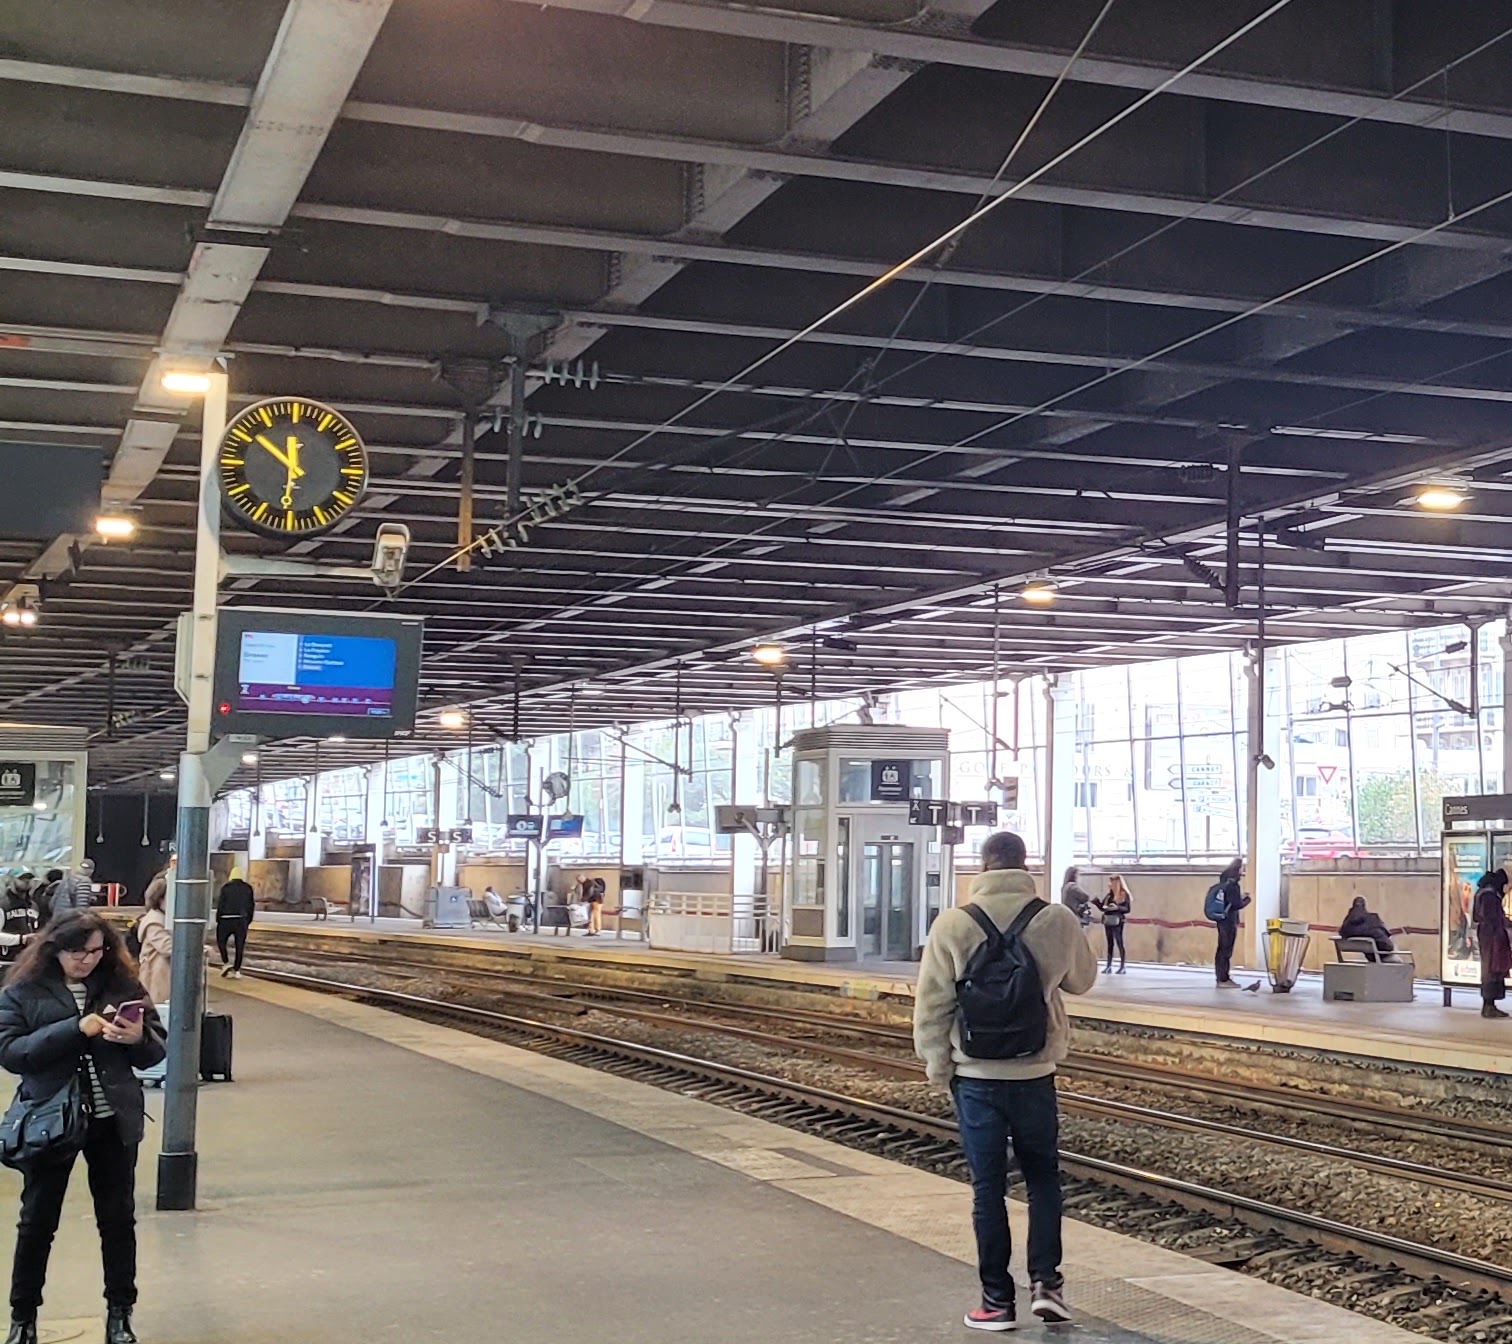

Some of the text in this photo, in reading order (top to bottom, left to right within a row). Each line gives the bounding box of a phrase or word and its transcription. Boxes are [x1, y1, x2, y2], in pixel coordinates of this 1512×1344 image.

[927, 805, 943, 824] T
[966, 806, 982, 825] T
[1445, 803, 1469, 816] Cannes
[427, 831, 437, 843] S
[452, 831, 462, 843] S
